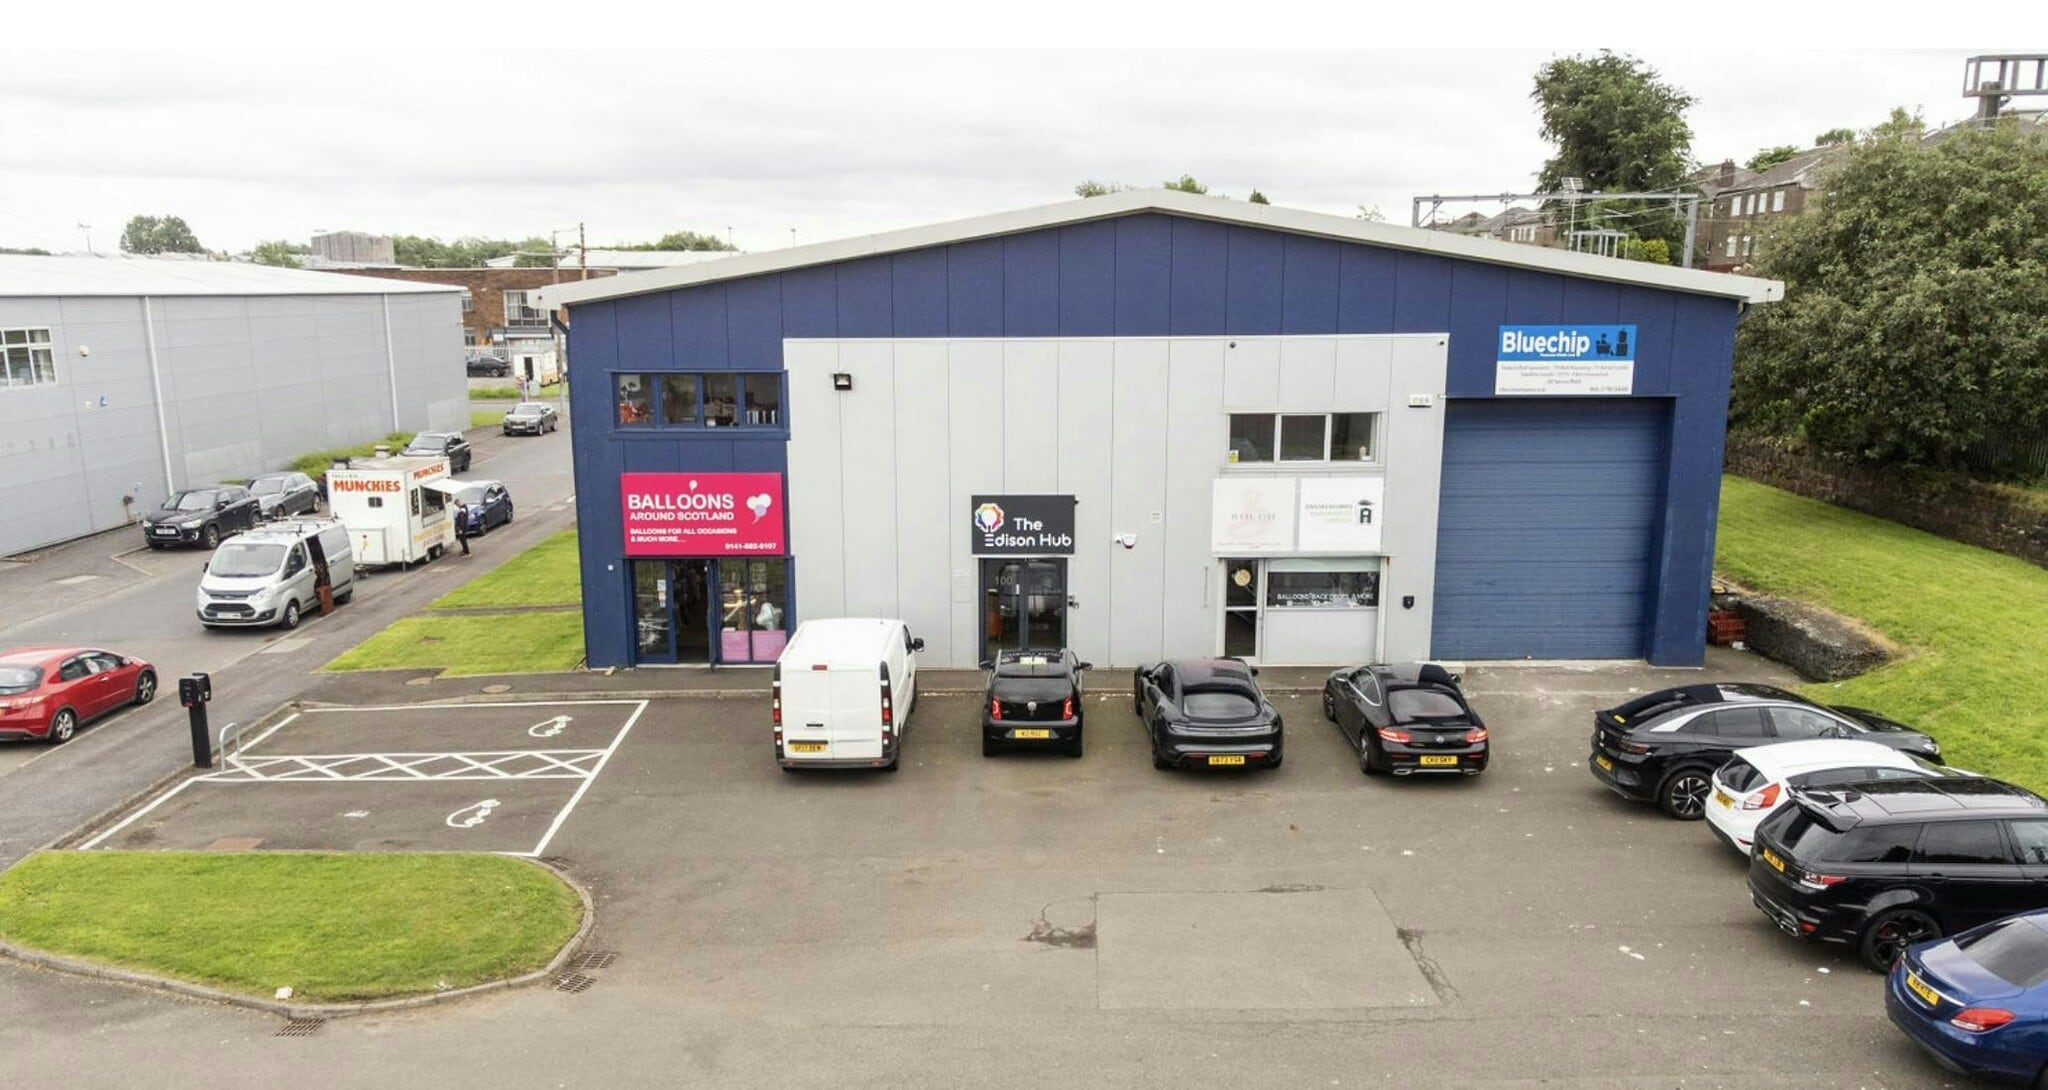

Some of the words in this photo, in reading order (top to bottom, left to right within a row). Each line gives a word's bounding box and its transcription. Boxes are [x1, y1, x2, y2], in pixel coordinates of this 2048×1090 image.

[1502, 330, 1590, 357] Bluechip
[628, 494, 734, 509] BALLOONS
[630, 512, 675, 520] AROUND
[677, 512, 734, 521] SCOTLAND
[630, 527, 667, 535] BALLOONS
[668, 527, 682, 535] FOR
[683, 527, 696, 535] ALL
[697, 527, 737, 535] OCCASIONS
[1013, 517, 1043, 531] The
[637, 535, 658, 543] MUCH
[985, 534, 1035, 547] Edison
[1040, 533, 1072, 547] Hub
